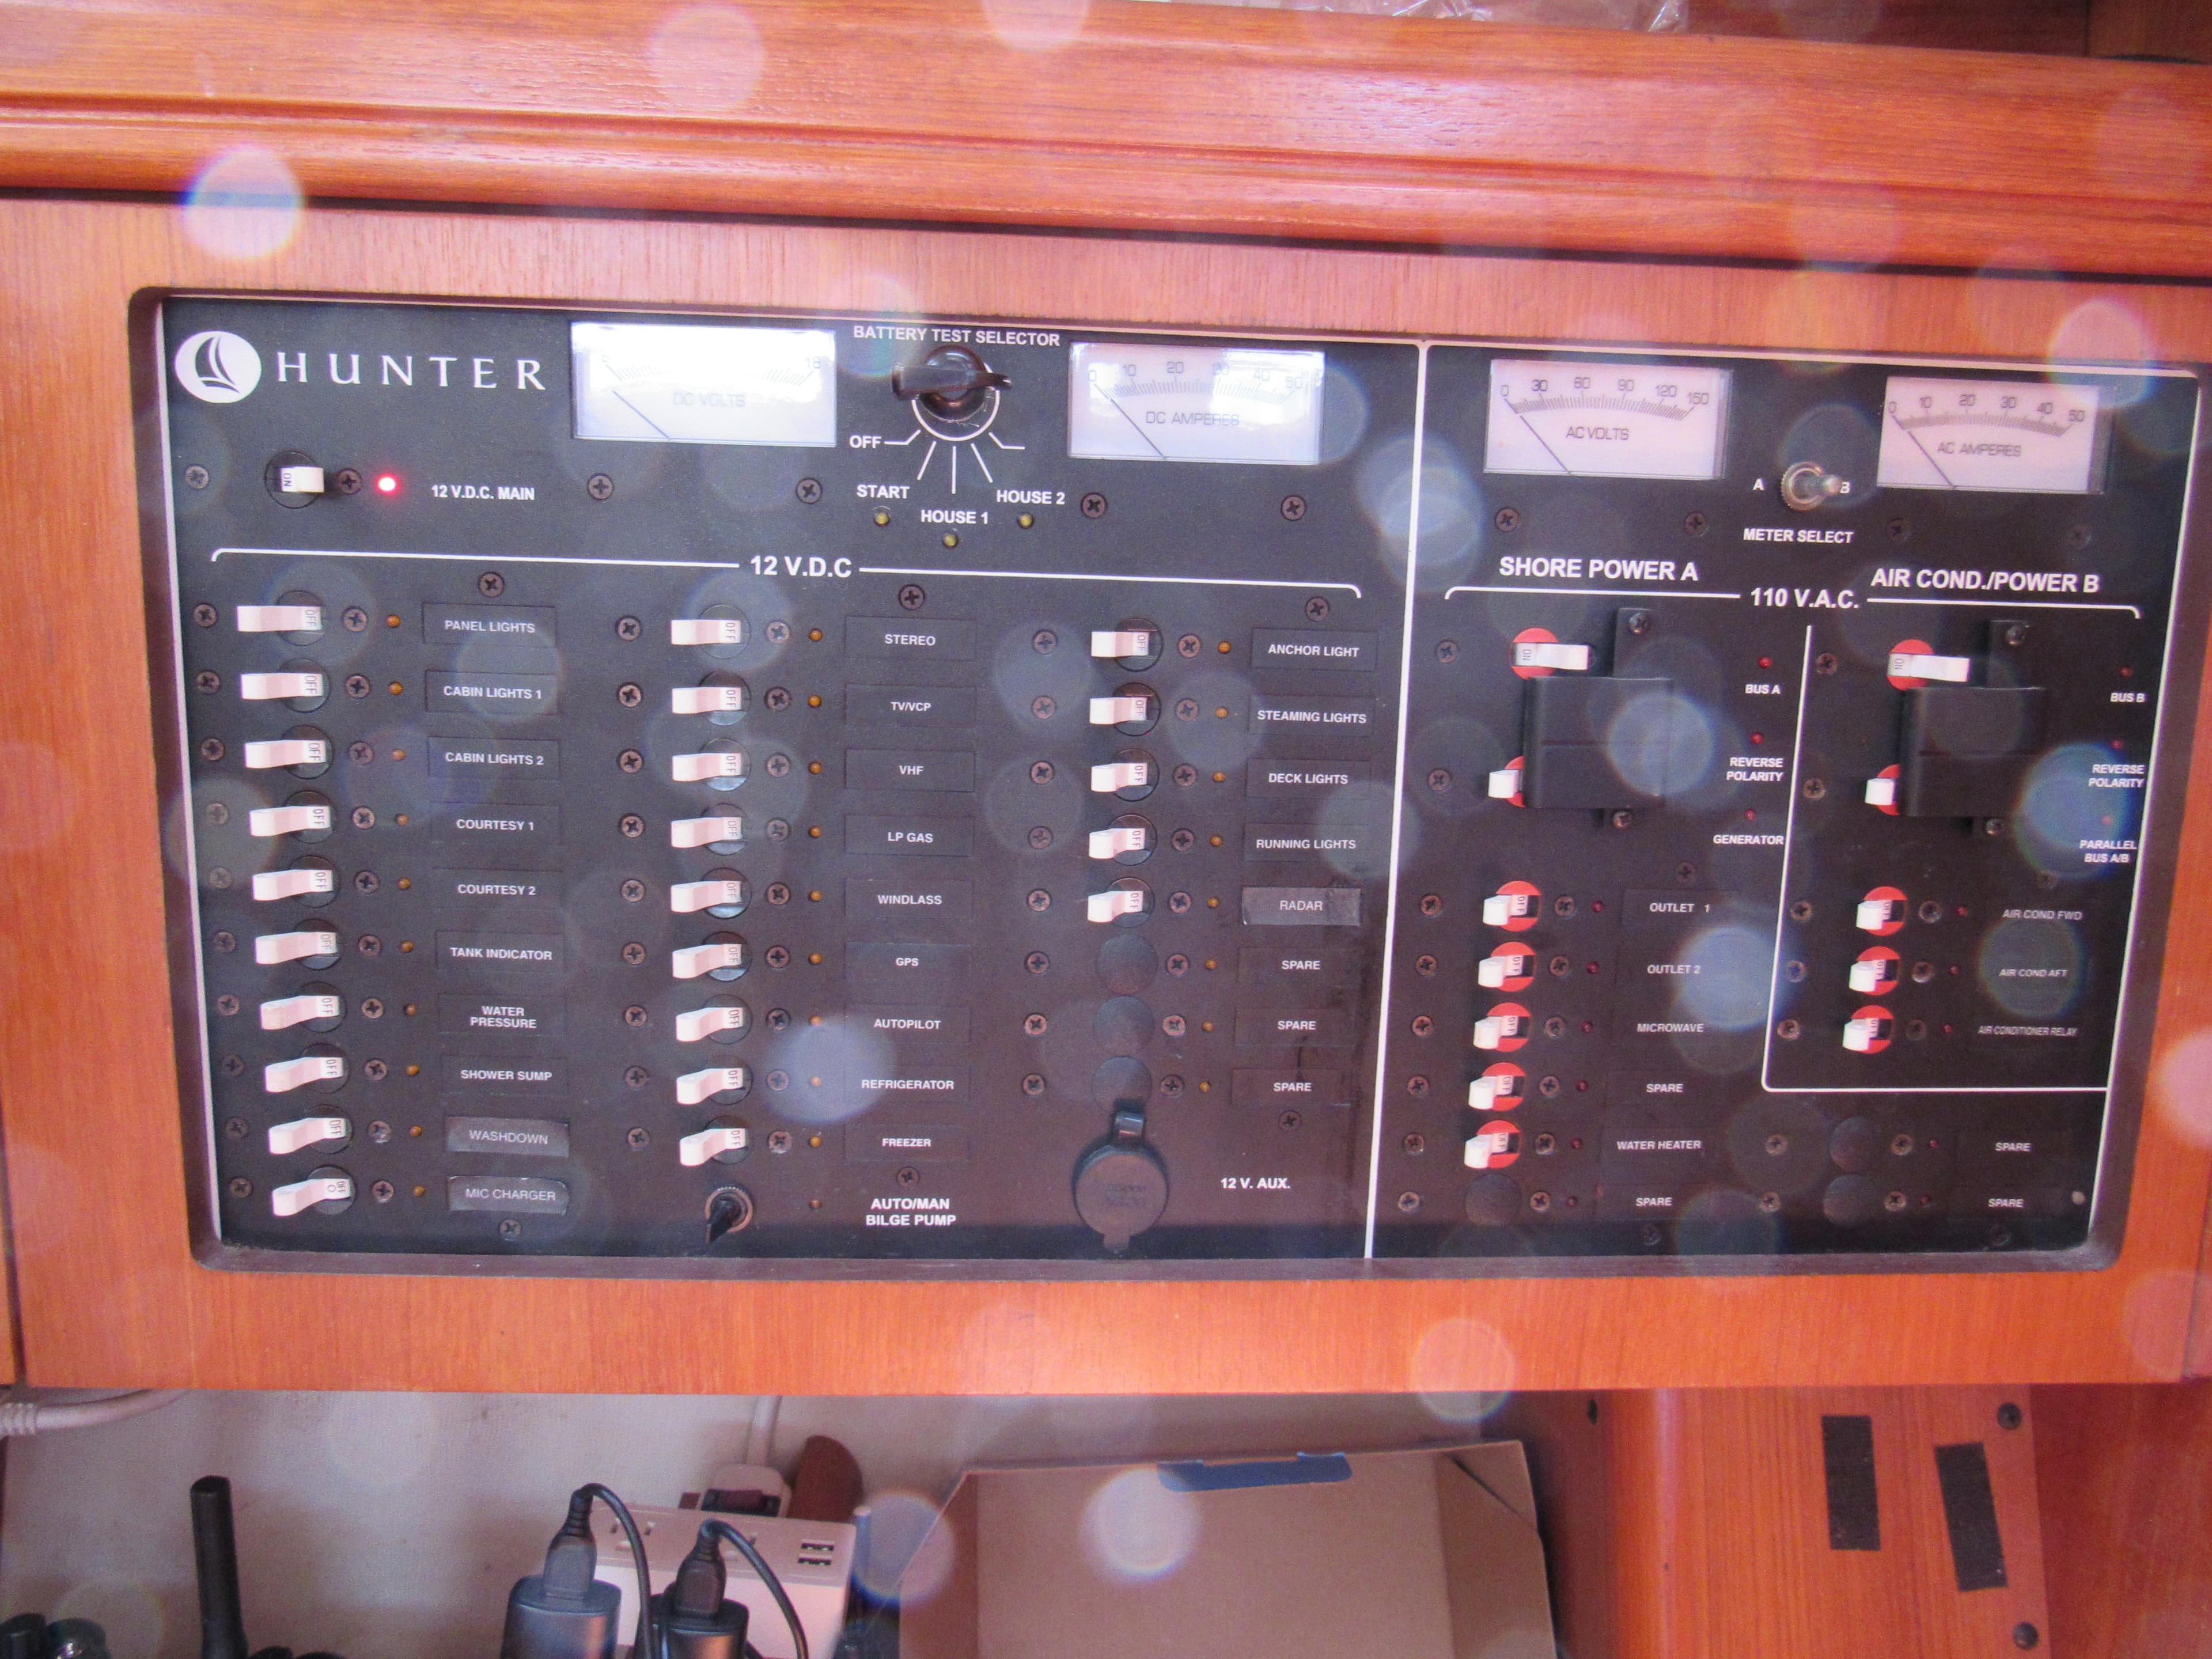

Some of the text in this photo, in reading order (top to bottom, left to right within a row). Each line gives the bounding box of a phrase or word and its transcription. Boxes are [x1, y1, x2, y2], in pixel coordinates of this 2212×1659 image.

[854, 325, 1059, 346] BATTERY TEST SELECTOR
[278, 352, 546, 390] HUNTER
[1123, 365, 1137, 377] 10
[1166, 362, 1184, 374] 20
[1532, 380, 1548, 392] 30
[1574, 377, 1590, 389] 60
[1618, 380, 1634, 392] 90
[1501, 385, 1509, 396] 0
[1654, 385, 1677, 397] 120
[1688, 393, 1709, 404] 150
[1919, 397, 1933, 409] 10
[1959, 395, 1976, 408] 20
[2001, 396, 2017, 409] 30
[1888, 402, 1897, 414] 0
[2037, 402, 2054, 415] 40
[1146, 411, 1239, 426] DC AMPERES
[2069, 410, 2085, 423] 50
[1567, 427, 1628, 440] AC VOLTS
[850, 435, 881, 448] OFF
[1938, 442, 2021, 457] AC AMPERES
[283, 473, 291, 487] ON
[1753, 479, 1764, 490] A
[432, 485, 535, 500] 12 V.D.C. MAIN
[857, 484, 910, 498] START
[1840, 482, 1850, 493] B
[997, 490, 1065, 505] HOUSE 2
[921, 510, 987, 524] HOUSE 1
[1744, 528, 1854, 543] METER SELECT
[751, 555, 851, 578] 12 V.D.C
[1499, 556, 1698, 581] SHORE POWER A
[1871, 569, 2099, 593] AIR COND./POWER B
[1751, 588, 1858, 608] 110 V.A.C.
[445, 620, 535, 633] PANEL LIGHTS
[726, 622, 736, 641] OFF
[885, 634, 935, 646] STEREO
[1137, 635, 1146, 653] OFF
[1268, 644, 1359, 657] ANCHOR LIGHT
[1522, 649, 1532, 661] ON
[1893, 658, 1904, 670] ON
[306, 675, 317, 694] OFF
[1745, 684, 1781, 695] BUS A
[444, 686, 541, 699] CABIN LIGHTS 1
[2111, 692, 2145, 702] BUS B
[727, 690, 736, 709] OFF
[891, 702, 931, 711] TV/VCP
[1257, 710, 1366, 724] STEAMING LIGHTS
[309, 743, 321, 762] OFF
[445, 752, 543, 765] CABIN LIGHTS 2
[726, 755, 736, 774] OFF
[1730, 757, 1783, 767] REVERSE
[899, 766, 923, 775] VHF
[1134, 765, 1143, 783] OFF
[2092, 764, 2144, 774] REVERSE
[1269, 773, 1348, 785] DECK LIGHTS
[1726, 771, 1783, 781] POLARITY
[2088, 778, 2143, 787] POLARITY
[313, 808, 324, 827] OFF
[456, 819, 533, 830] COURTESY 1
[888, 832, 933, 843] LP GAS
[1132, 831, 1142, 849] OFF
[1713, 835, 1784, 844] GENERATOR
[1256, 839, 1356, 849] RUNNING LIGHTS
[2080, 840, 2137, 849] PARALLEL
[2085, 853, 2129, 862] BUS A/B
[458, 884, 535, 895] COURTESY 2
[878, 895, 942, 904] WINDLASS
[1280, 900, 1323, 910] RADAR
[1517, 896, 1526, 914] OFF
[1650, 903, 1710, 912] OUTLET 1
[2002, 909, 2082, 920] AIR COND FWD
[450, 948, 552, 960] TANK INDICATOR
[896, 957, 918, 966] GPS
[1282, 960, 1320, 969] SPARE
[1513, 957, 1521, 974] OFF
[1647, 964, 1700, 974] OUTLET 2
[2018, 968, 2046, 978] COND
[482, 1006, 524, 1016] WATER
[471, 1017, 536, 1028] PRESSURE
[874, 1019, 941, 1029] AUTOPILOT
[1278, 1021, 1316, 1030] SPARE
[1637, 1023, 1704, 1033] MICROWAVE
[1978, 1025, 1993, 1035] AIR
[2050, 1027, 2077, 1036] RELAY
[326, 1059, 337, 1077] OFF
[461, 1070, 552, 1081] SHOWER SUMP
[862, 1079, 955, 1090] REFRIGERATOR
[1274, 1082, 1311, 1092] SPARE
[1647, 1084, 1683, 1093] SPARE
[330, 1119, 341, 1137] OFF
[469, 1130, 548, 1144] WASHDOWN
[882, 1138, 931, 1147] FREEZER
[1617, 1141, 1701, 1150] WATER HEATER
[1995, 1142, 2030, 1152] SPARE
[1221, 1178, 1290, 1189] 12 V. AUX.
[465, 1188, 555, 1200] MIC CHARGER
[871, 1198, 949, 1209] AUTO/MAN
[1636, 1197, 1672, 1206] SPARE
[1988, 1199, 2023, 1207] SPARE
[866, 1214, 956, 1225] BILGE PUMP
